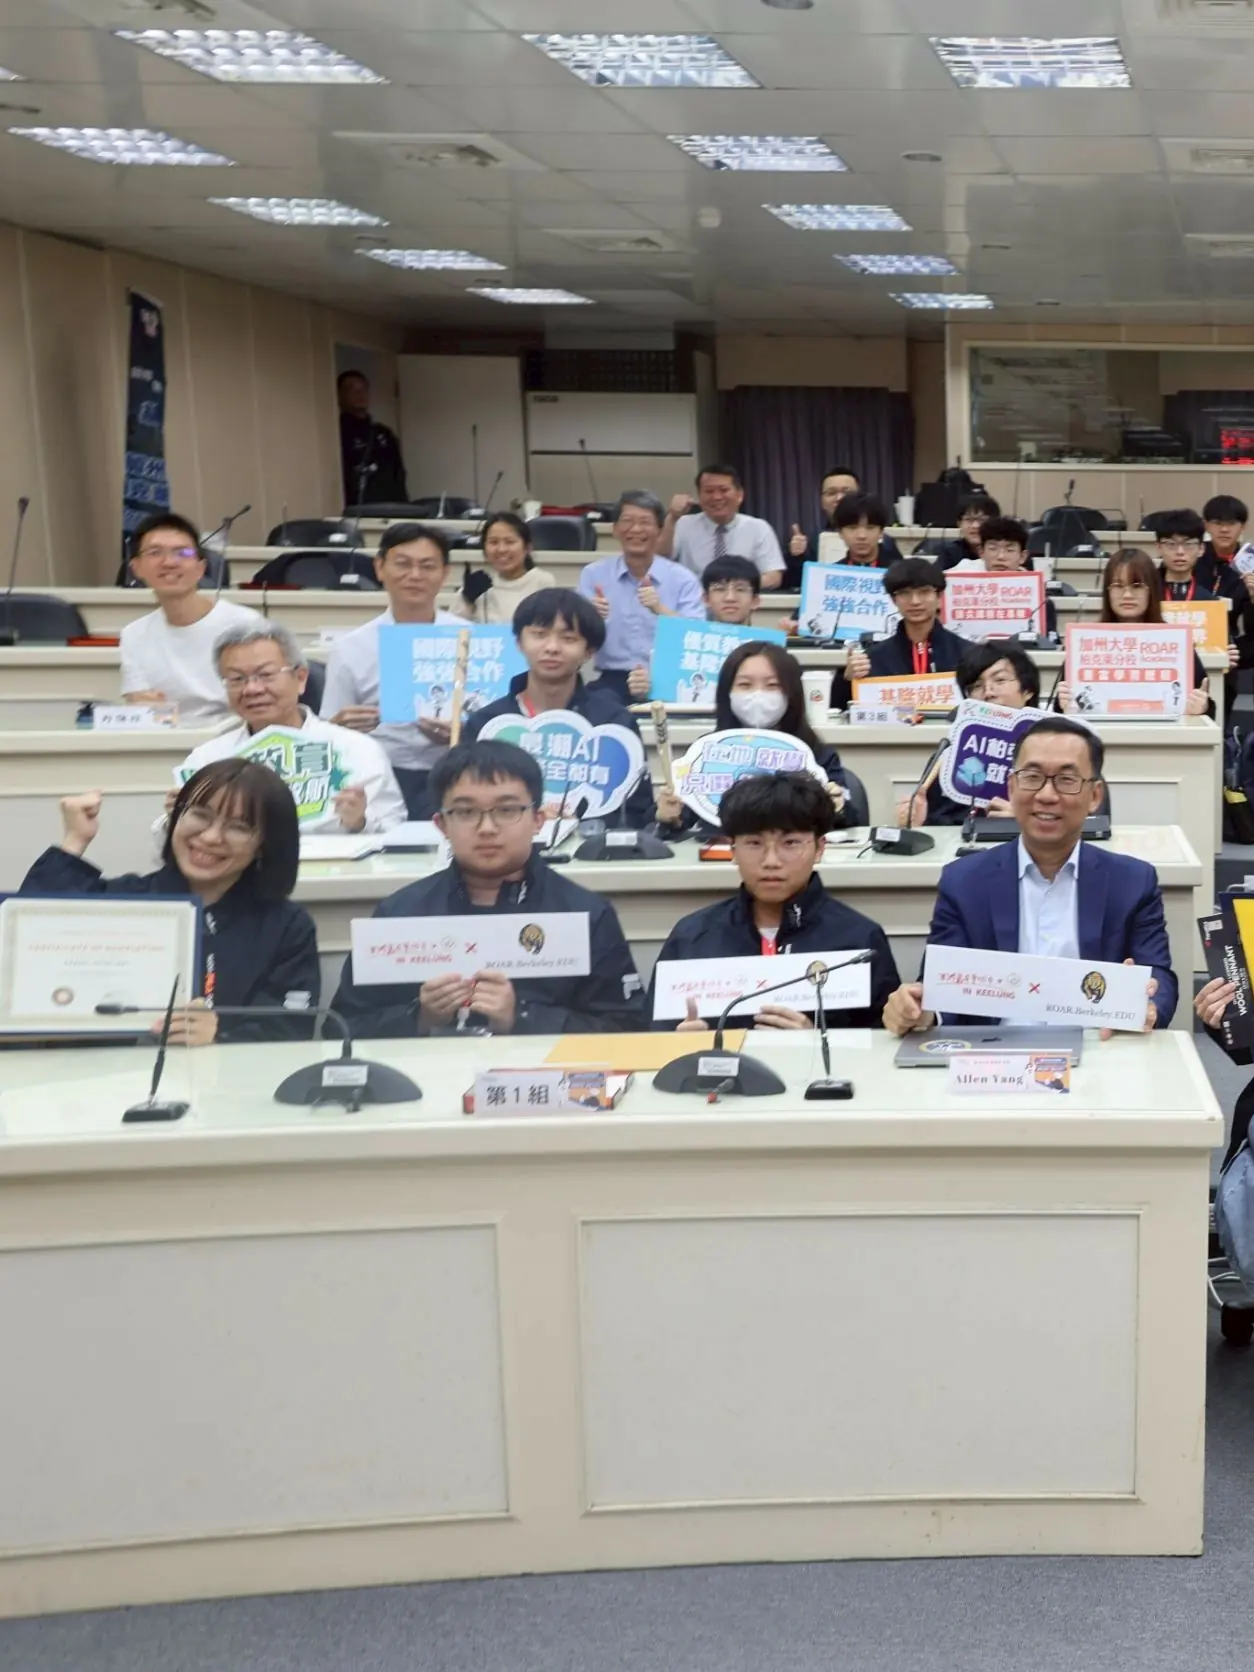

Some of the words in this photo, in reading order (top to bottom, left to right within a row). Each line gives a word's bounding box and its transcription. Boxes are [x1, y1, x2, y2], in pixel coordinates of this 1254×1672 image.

[1078, 636, 1138, 653] 加州大學
[1139, 641, 1180, 655] ROAR
[975, 988, 1017, 1000] KEELUNG
[954, 1073, 989, 1085] Allen
[992, 1074, 1025, 1086] Yang
[485, 1084, 550, 1107] 第1組
